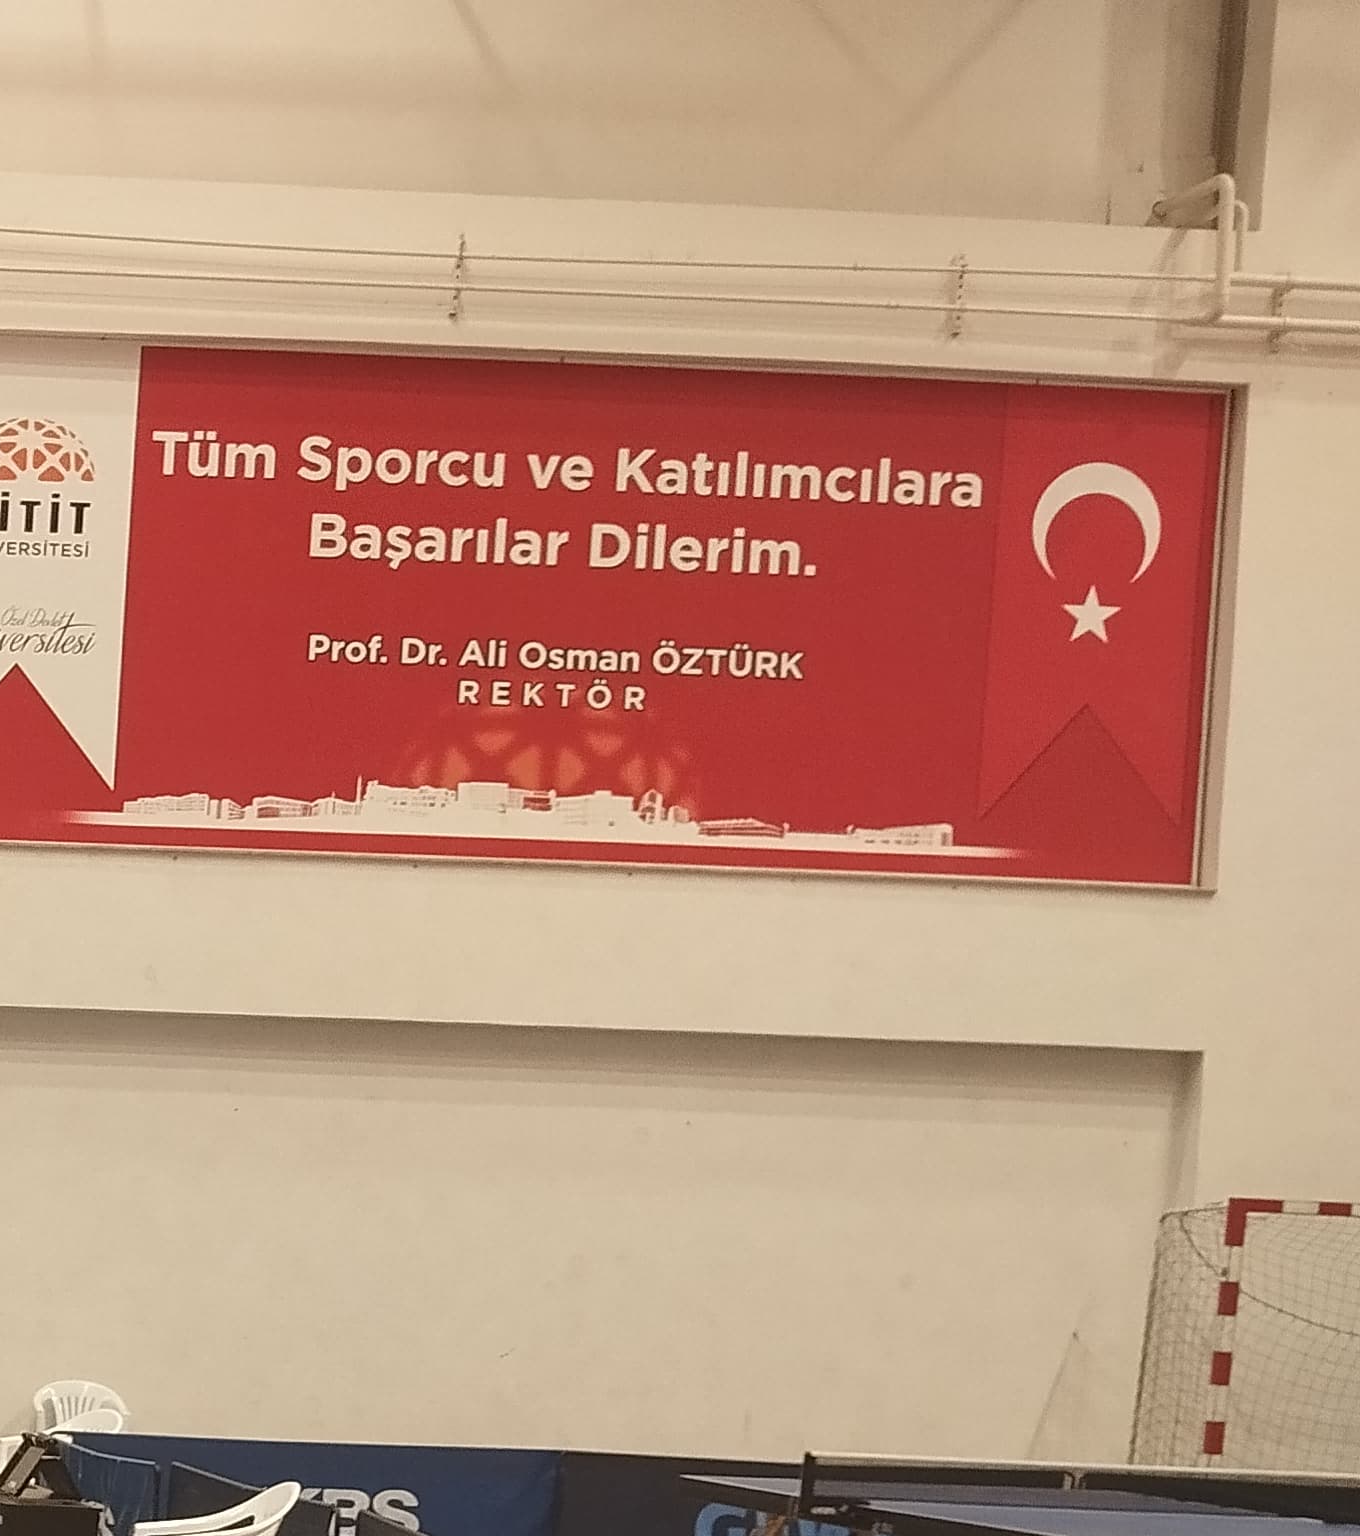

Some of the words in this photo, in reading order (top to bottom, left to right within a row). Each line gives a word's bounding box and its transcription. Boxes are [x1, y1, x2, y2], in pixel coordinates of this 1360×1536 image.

[152, 430, 276, 480] Tüm
[297, 436, 505, 490] Sporcu
[527, 456, 594, 491] ve
[615, 449, 983, 508] Katılımcılara
[309, 513, 569, 569] Başarılar
[588, 524, 817, 576] Dilerim.
[308, 634, 388, 664] Prof.
[401, 638, 447, 666] Dr.
[459, 639, 506, 668] Ali
[519, 643, 640, 673] Osman
[652, 646, 803, 679] ÖZTÜRK
